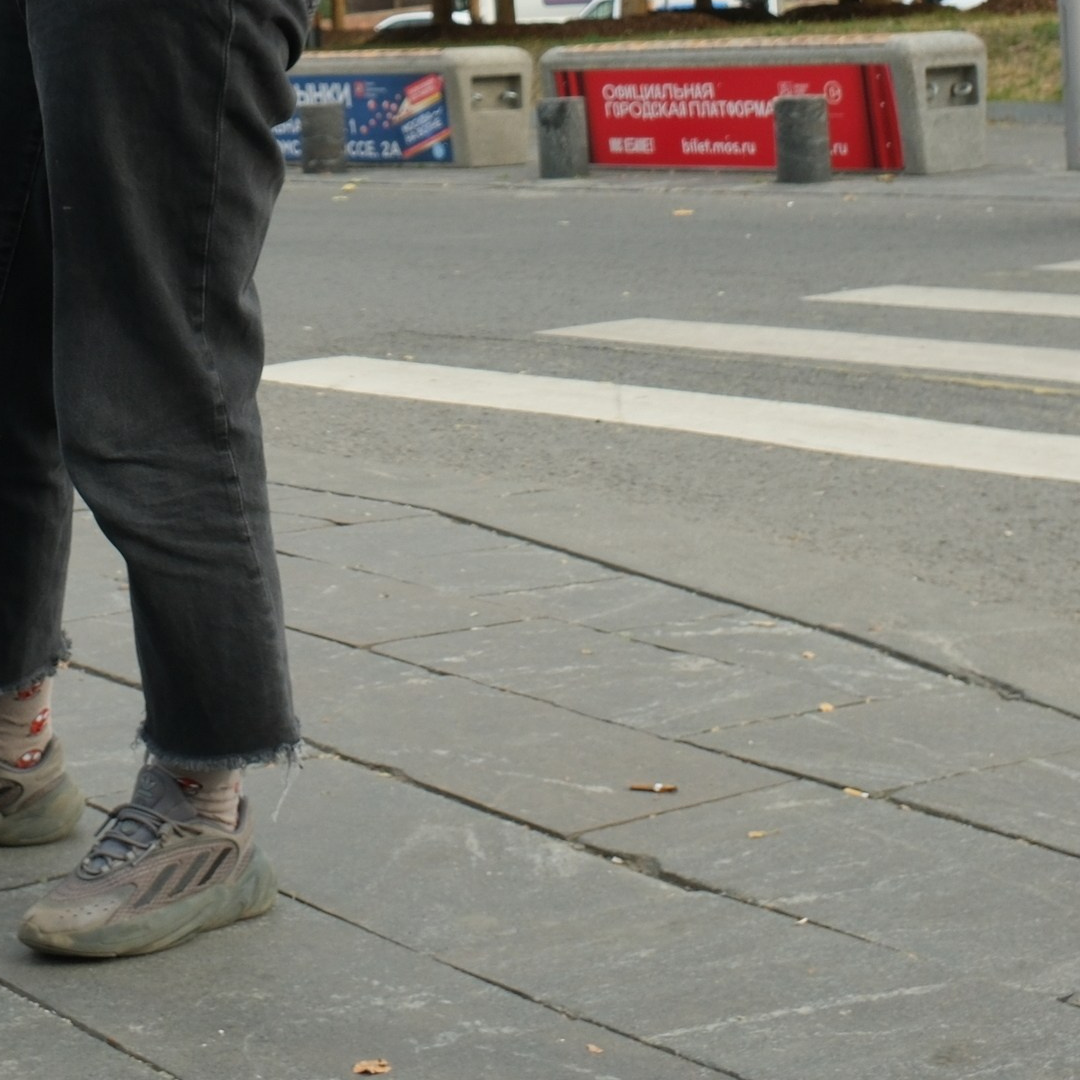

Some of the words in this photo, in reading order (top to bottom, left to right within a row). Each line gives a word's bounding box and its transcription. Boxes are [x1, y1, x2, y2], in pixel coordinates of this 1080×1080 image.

[602, 83, 715, 100] ОФИЦИАЛЬНАЯ
[604, 100, 686, 120] ГОРОДСКАЯ
[688, 100, 774, 118] ПЛАТФОРМА
[682, 137, 756, 155] bilet.mos.ru
